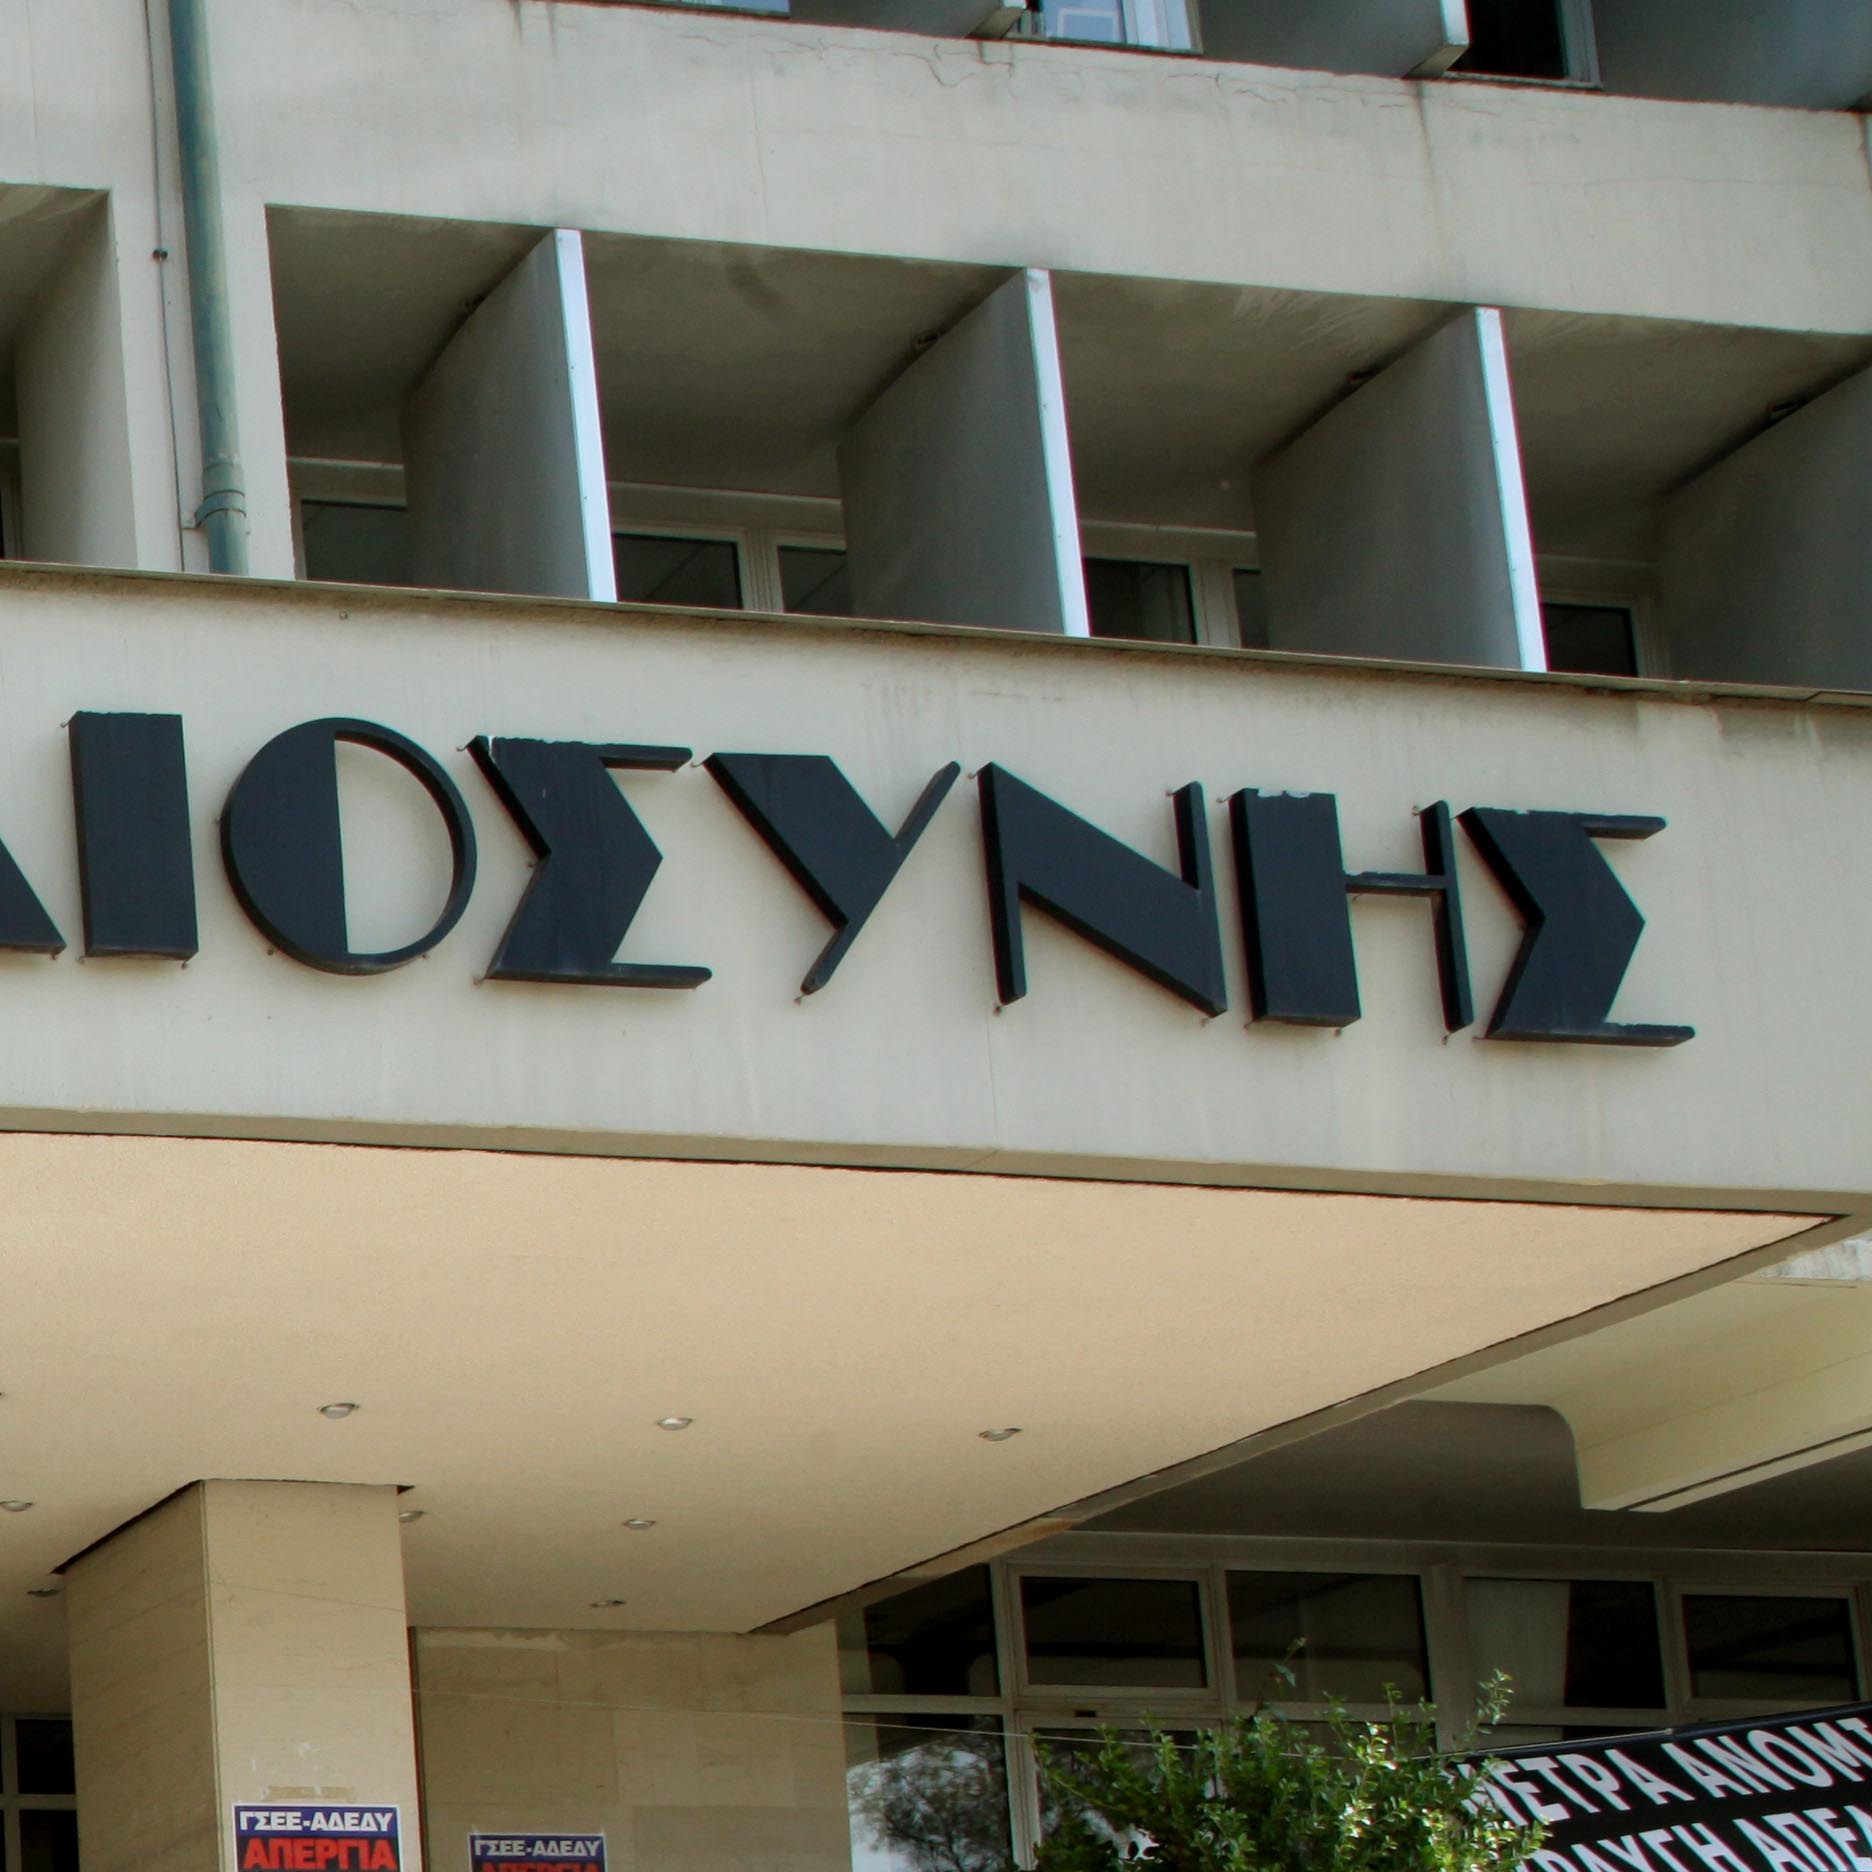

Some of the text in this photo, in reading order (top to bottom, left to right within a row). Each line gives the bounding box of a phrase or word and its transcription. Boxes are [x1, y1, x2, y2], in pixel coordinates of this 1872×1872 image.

[239, 1811, 393, 1832] ΓΣΕΕ-ΑΔΕΔΥ
[243, 1837, 397, 1871] ΑΠΕΡΓΙΑ
[474, 1840, 601, 1857] ΓΣΕΕ-ΑΔΕΔΥ
